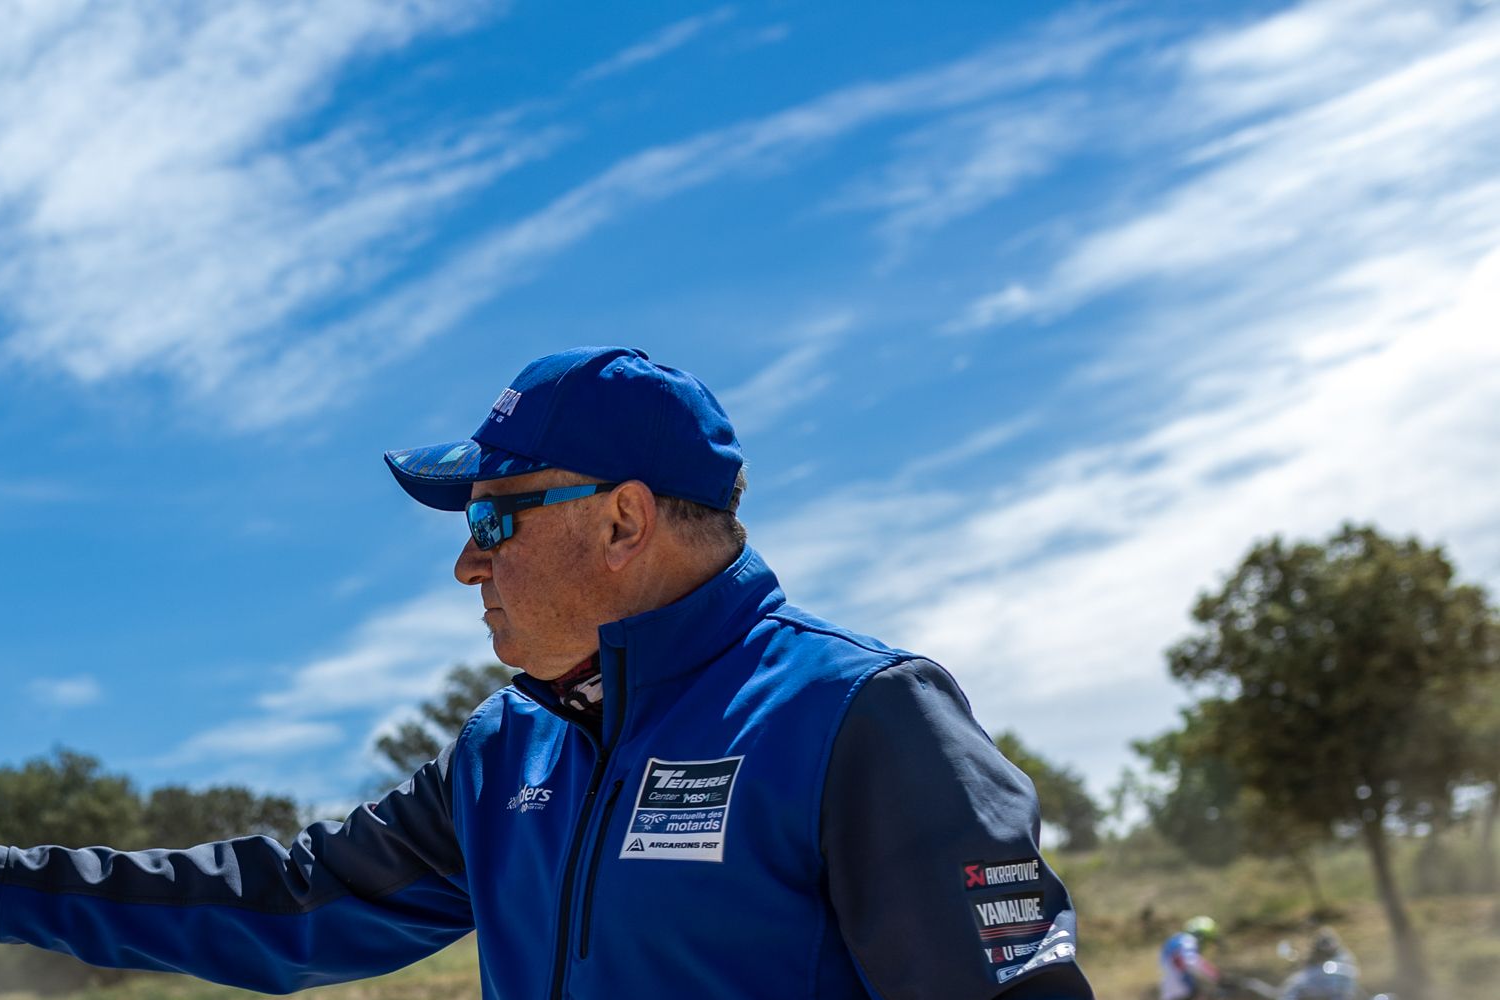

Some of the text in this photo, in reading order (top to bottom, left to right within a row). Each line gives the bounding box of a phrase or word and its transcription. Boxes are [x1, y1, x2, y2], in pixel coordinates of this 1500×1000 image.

[648, 791, 680, 800] Center
[669, 811, 723, 820] mutuelle des
[666, 818, 720, 831] motards
[648, 841, 700, 849] ARCARONS
[701, 841, 719, 849] RST
[976, 898, 1044, 926] YAMALUBE
